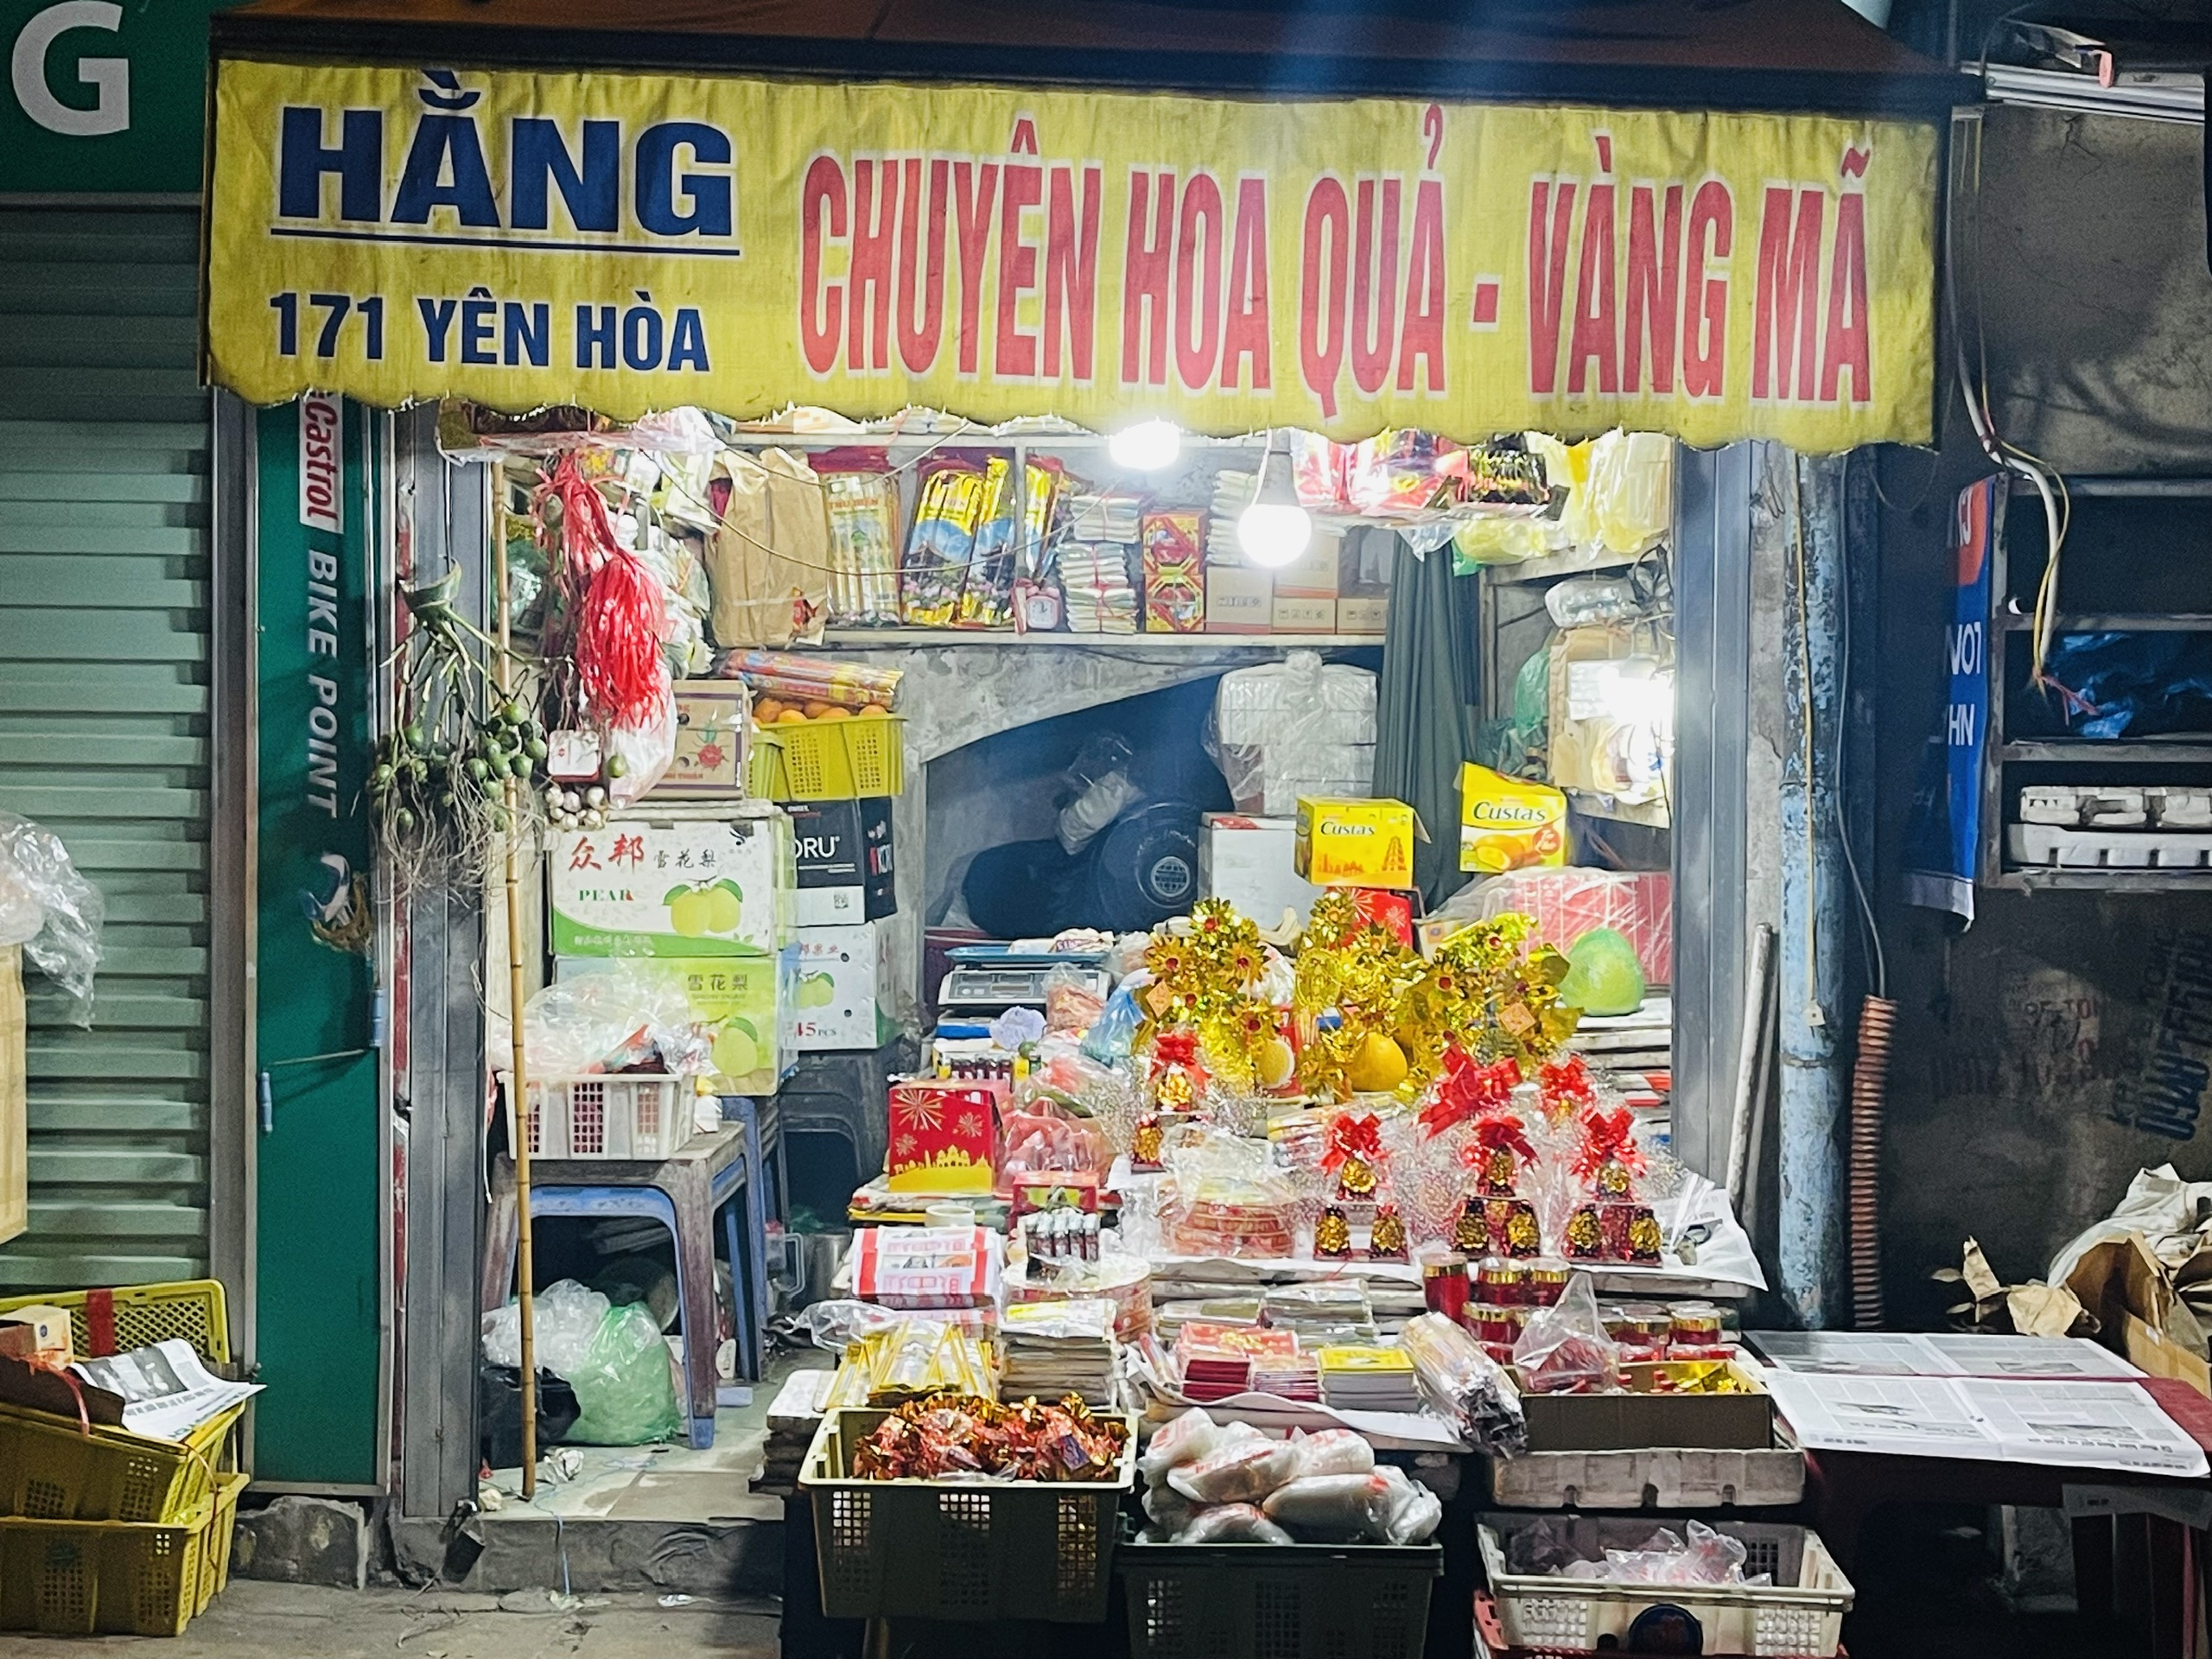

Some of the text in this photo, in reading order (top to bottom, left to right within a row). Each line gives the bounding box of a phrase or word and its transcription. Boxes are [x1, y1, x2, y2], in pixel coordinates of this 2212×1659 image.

[280, 70, 732, 237] HẰNG
[801, 118, 1102, 382] CHUYÊN
[1122, 172, 1272, 390] HOA
[1301, 104, 1446, 418] QUẢ
[1529, 135, 1732, 398] VÀNG
[1751, 147, 1872, 403] MÃ
[270, 287, 710, 372] 171 YÊN HÒA
[305, 401, 339, 521] Castrol
[308, 549, 338, 819] BIKE POINT
[1320, 821, 1376, 836] Custas
[1474, 802, 1547, 822] Custas
[579, 889, 634, 901] PEAR
